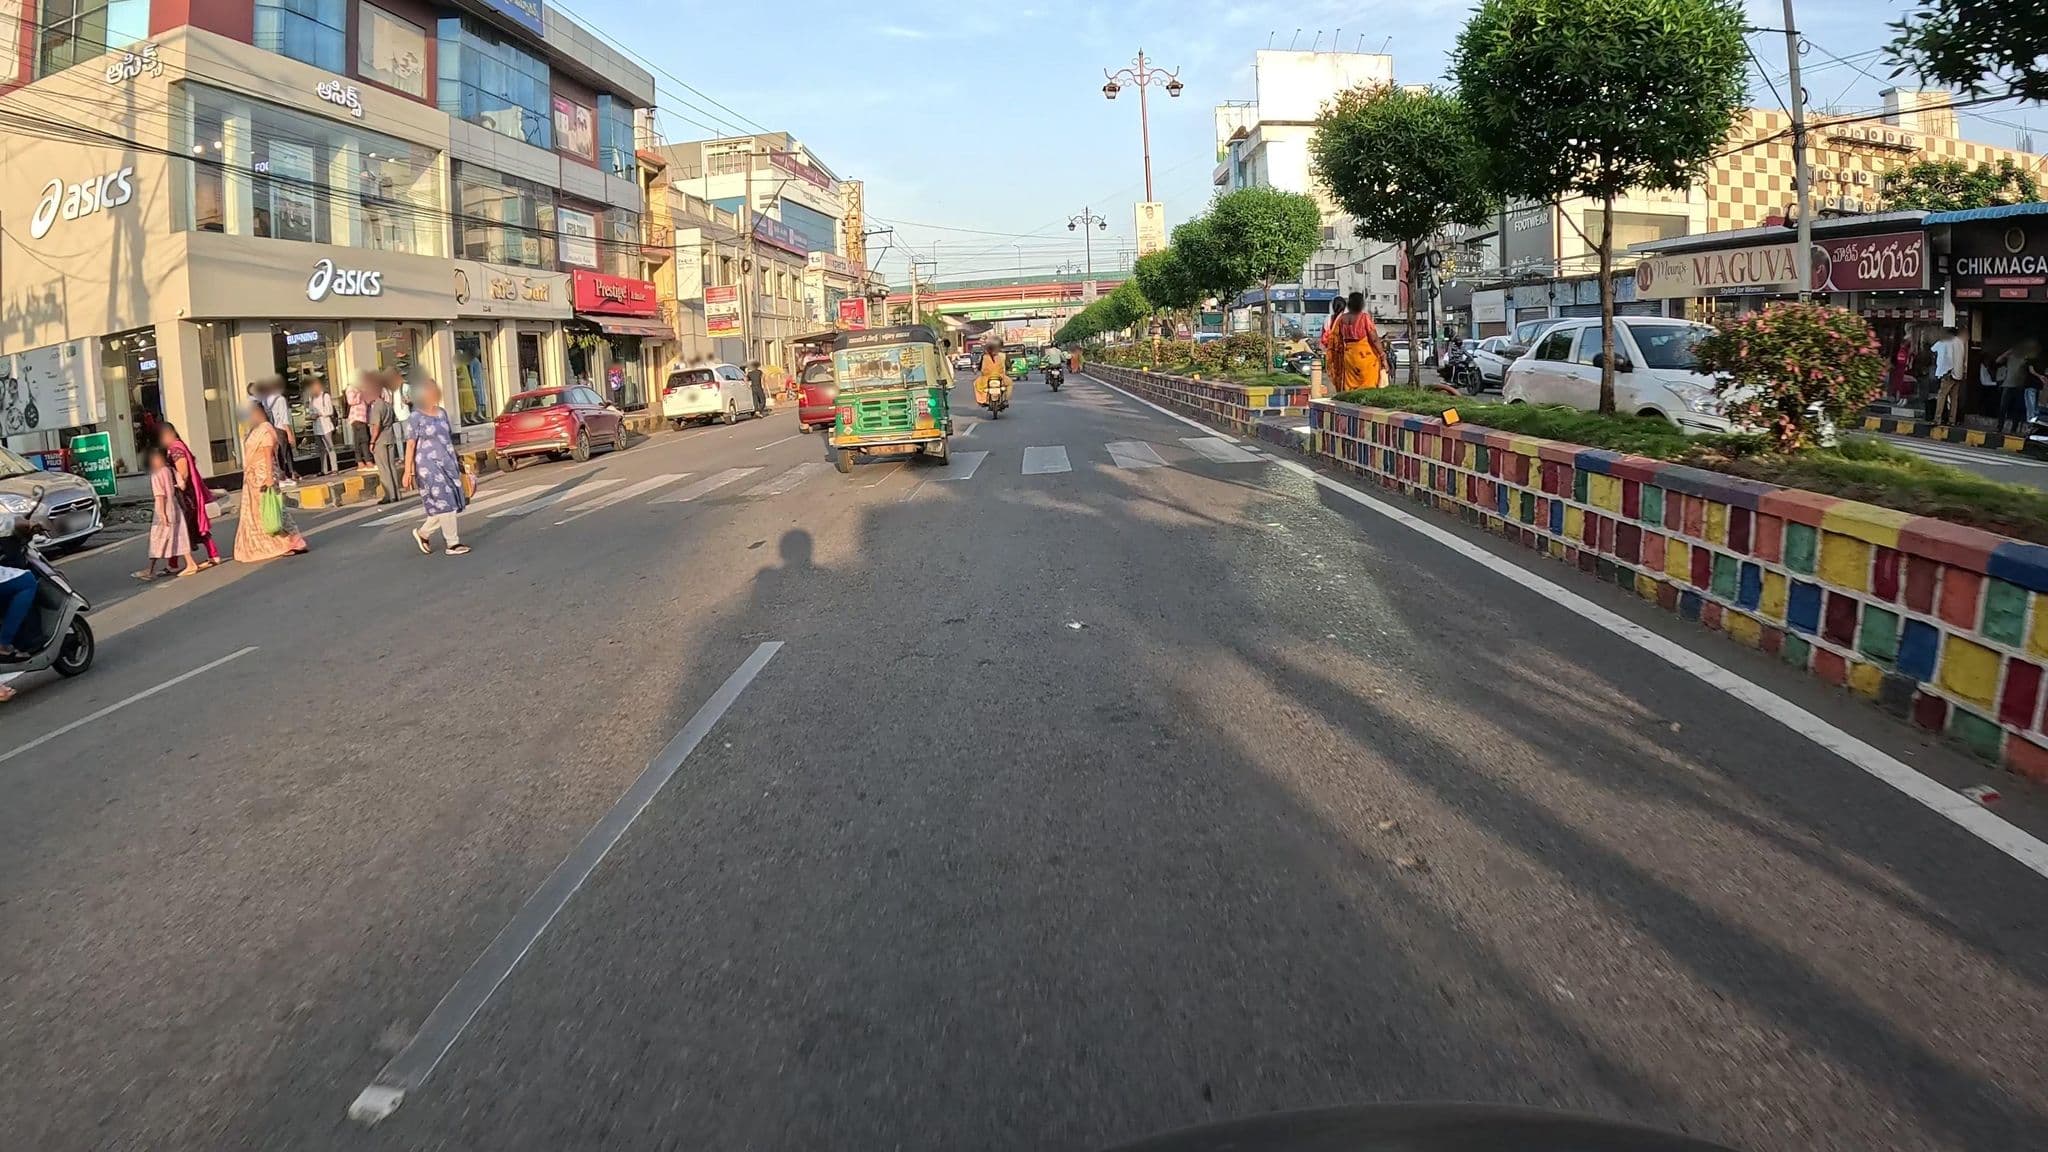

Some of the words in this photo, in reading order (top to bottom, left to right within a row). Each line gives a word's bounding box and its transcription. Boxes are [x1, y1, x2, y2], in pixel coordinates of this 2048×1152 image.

[1514, 212, 1549, 232] FOOTWEAR
[1692, 248, 1798, 285] MAGUVA
[1956, 256, 2048, 276] CHIKMAGA
[594, 279, 628, 303] Prestige
